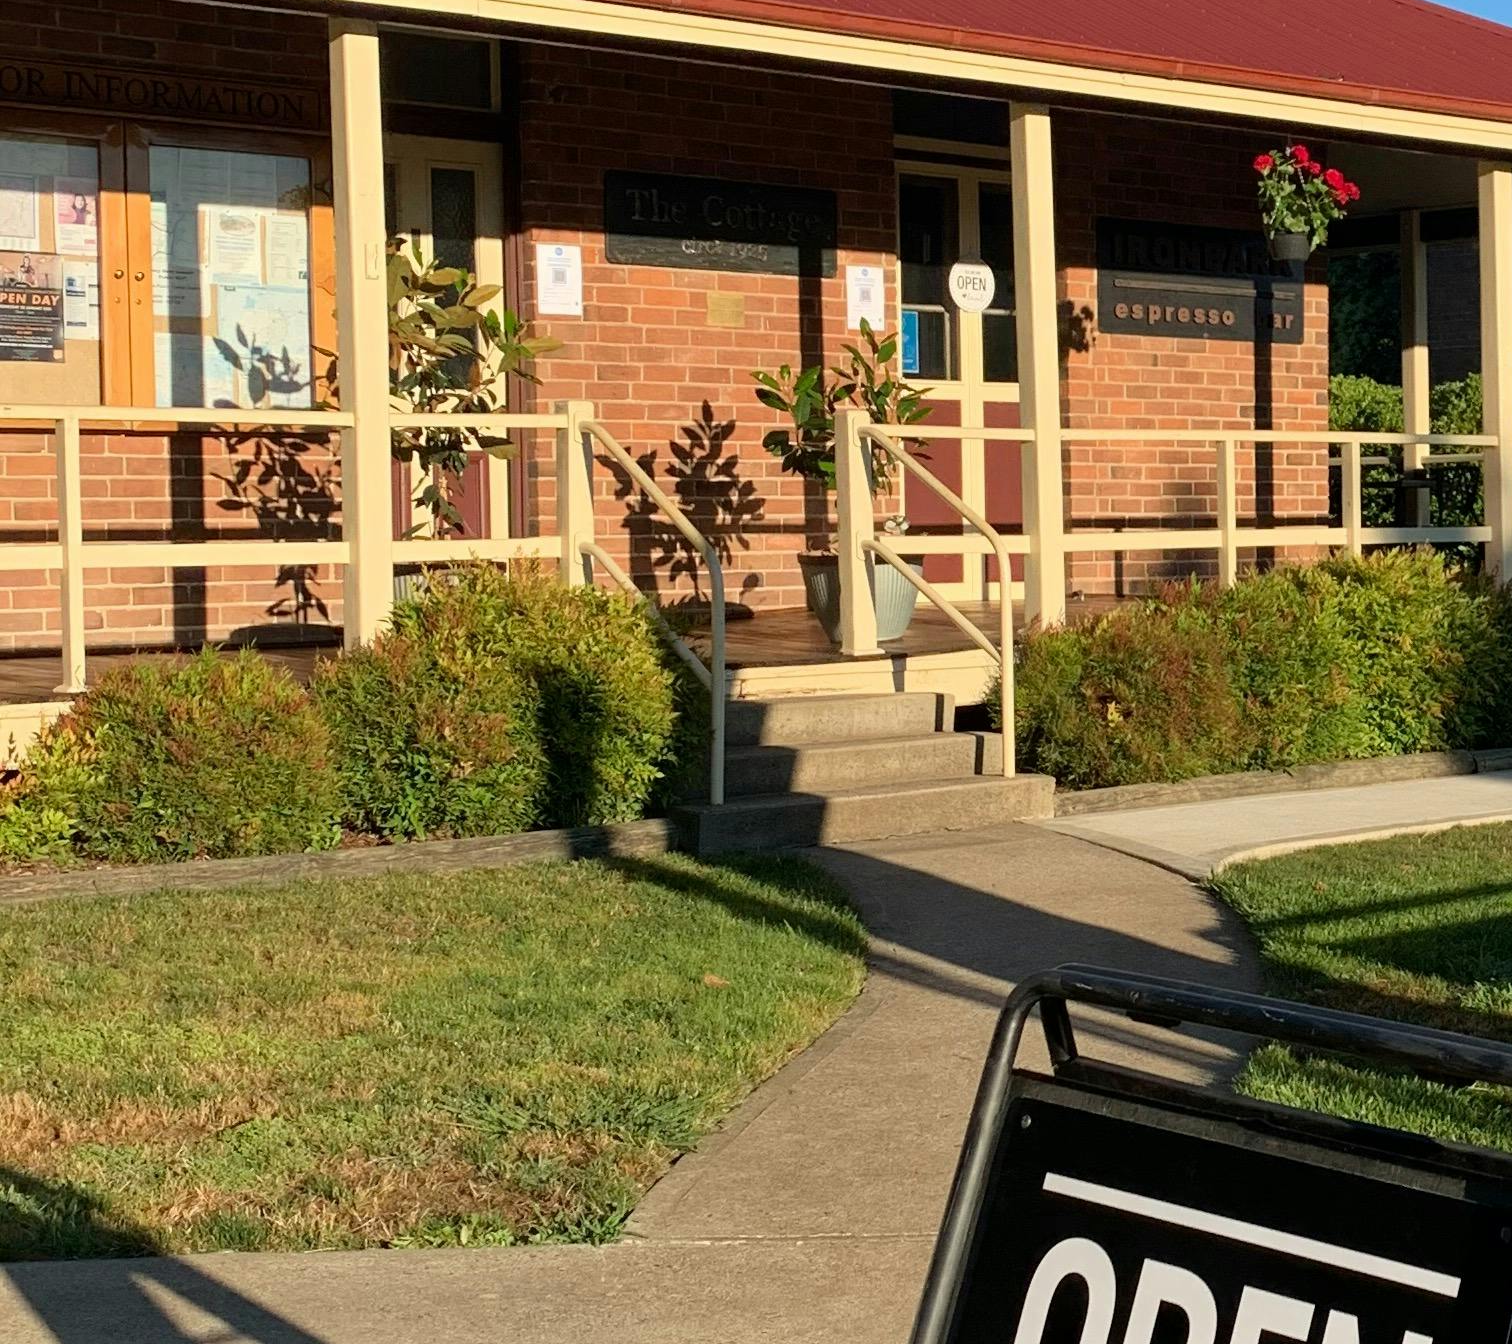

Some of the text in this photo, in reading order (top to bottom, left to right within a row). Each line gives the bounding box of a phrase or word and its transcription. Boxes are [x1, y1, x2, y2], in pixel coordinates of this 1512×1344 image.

[62, 70, 306, 121] INFORMATION
[625, 188, 687, 224] The
[957, 275, 987, 292] OPEN
[32, 294, 60, 306] DAY
[1115, 302, 1236, 326] espresso
